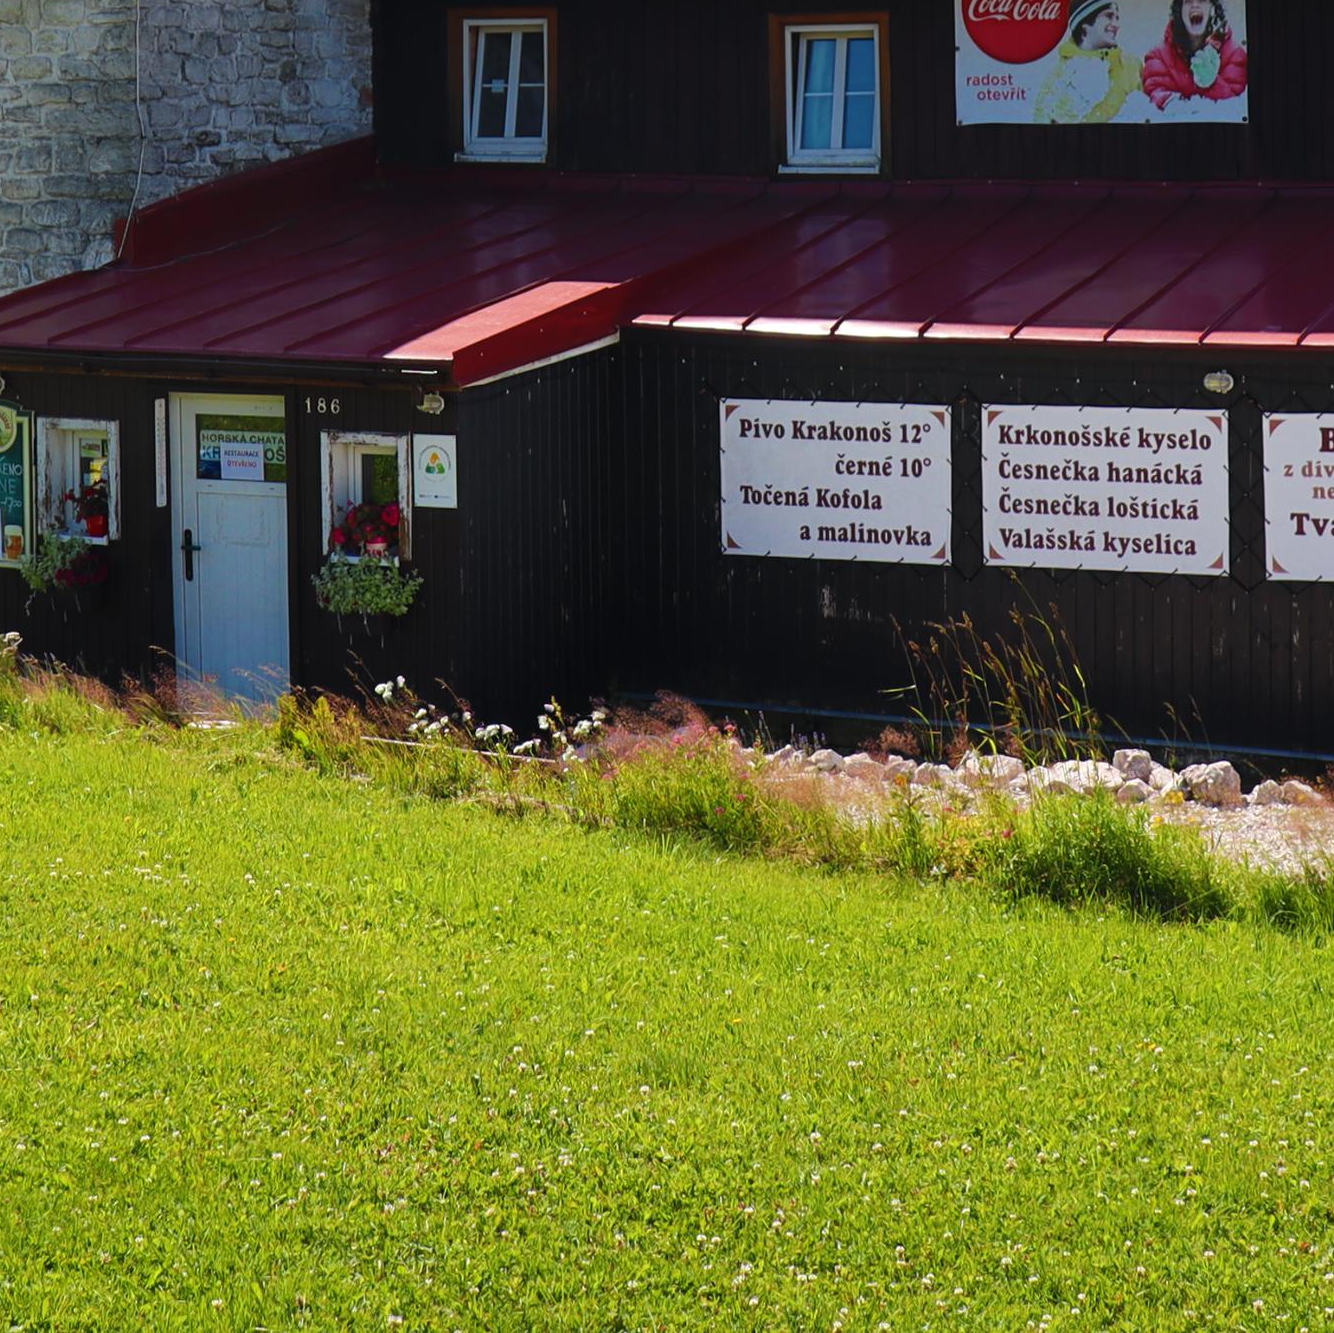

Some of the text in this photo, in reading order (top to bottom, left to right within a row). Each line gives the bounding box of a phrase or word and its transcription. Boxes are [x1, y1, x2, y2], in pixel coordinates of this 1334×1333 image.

[966, 72, 1014, 86] radost
[977, 87, 1027, 101] otevřít
[305, 397, 340, 414] 186
[202, 433, 285, 445] HORSKÁ CHATA
[739, 418, 931, 444] Pivo Krakonoš 12°
[998, 424, 1212, 454] Krkonošské kyselo
[835, 453, 931, 478] černé 10°
[998, 452, 1203, 485] Česnečka hanácká
[1283, 464, 1294, 477] z
[740, 484, 882, 510] Točená Kofola
[999, 486, 1199, 521] Česnečka loštická
[799, 523, 932, 546] a malinovka
[999, 527, 1197, 558] Valašská kyselica
